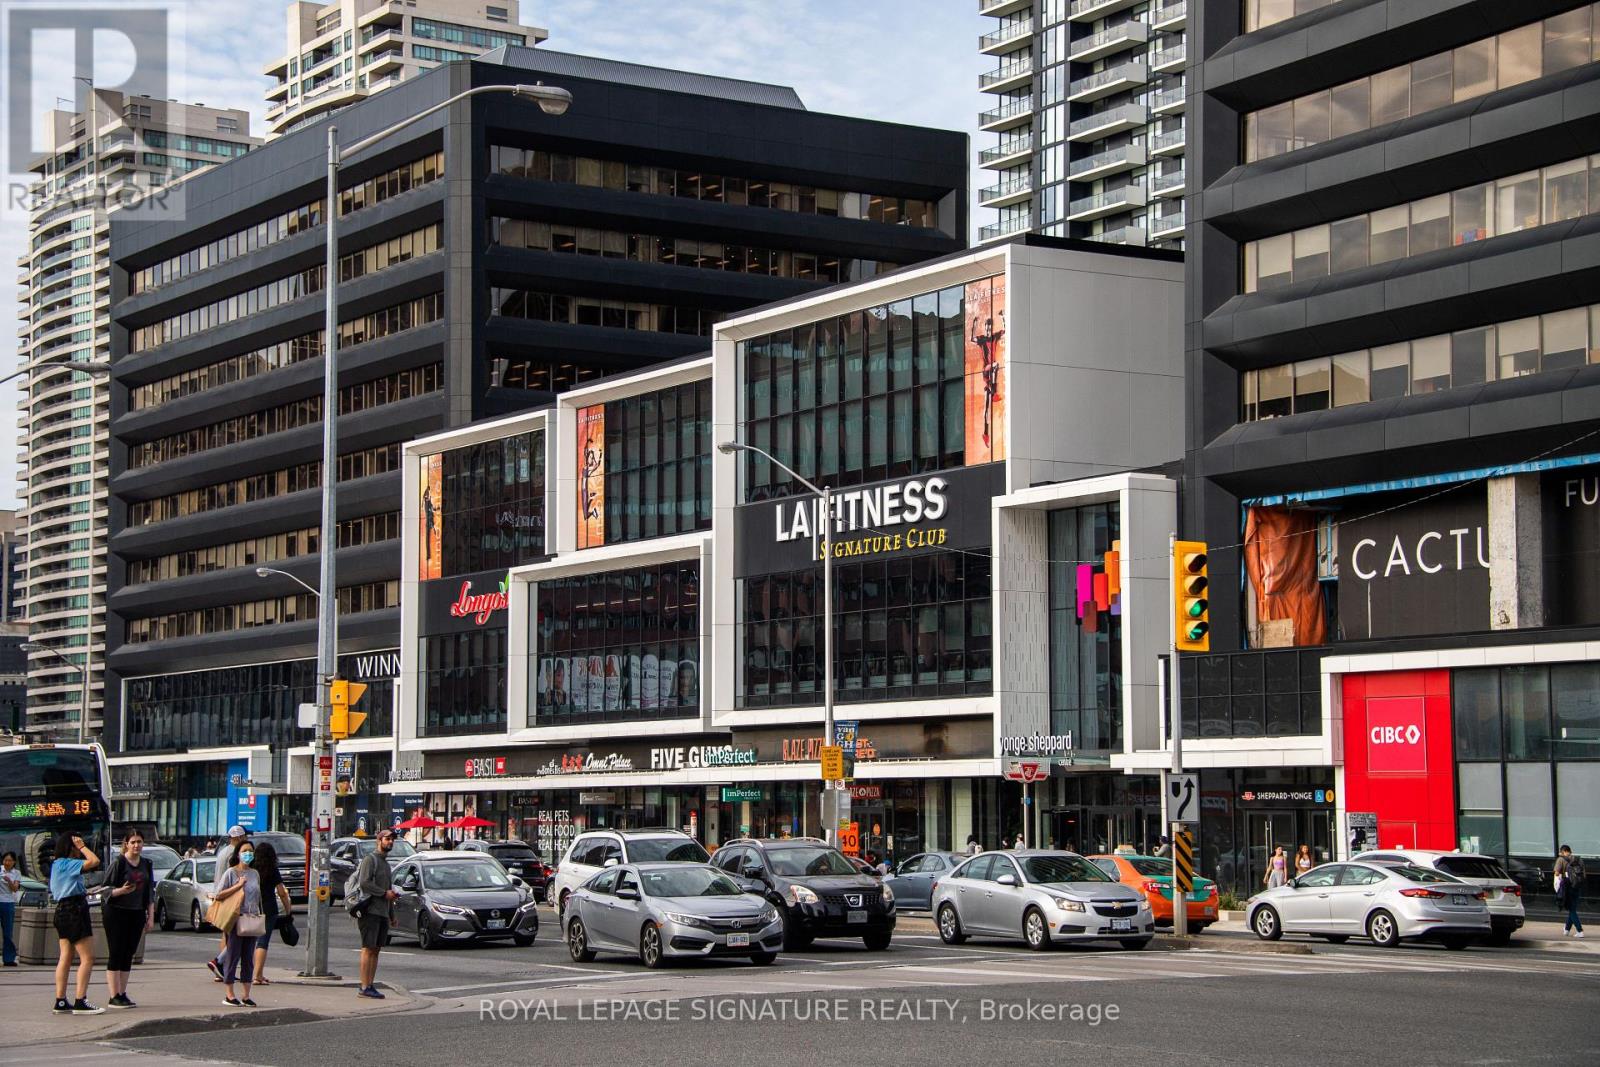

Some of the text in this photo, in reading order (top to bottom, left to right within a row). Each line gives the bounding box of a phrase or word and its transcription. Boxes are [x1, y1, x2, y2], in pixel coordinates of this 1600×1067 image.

[775, 477, 949, 542] LA FITNESS
[1028, 729, 1072, 755] sheppard
[1371, 725, 1405, 745] CIBC
[473, 758, 496, 777] BASIL
[650, 747, 684, 769] FIVE
[538, 811, 553, 821] REAL
[538, 825, 553, 836] REAL
[538, 839, 553, 850] REAL
